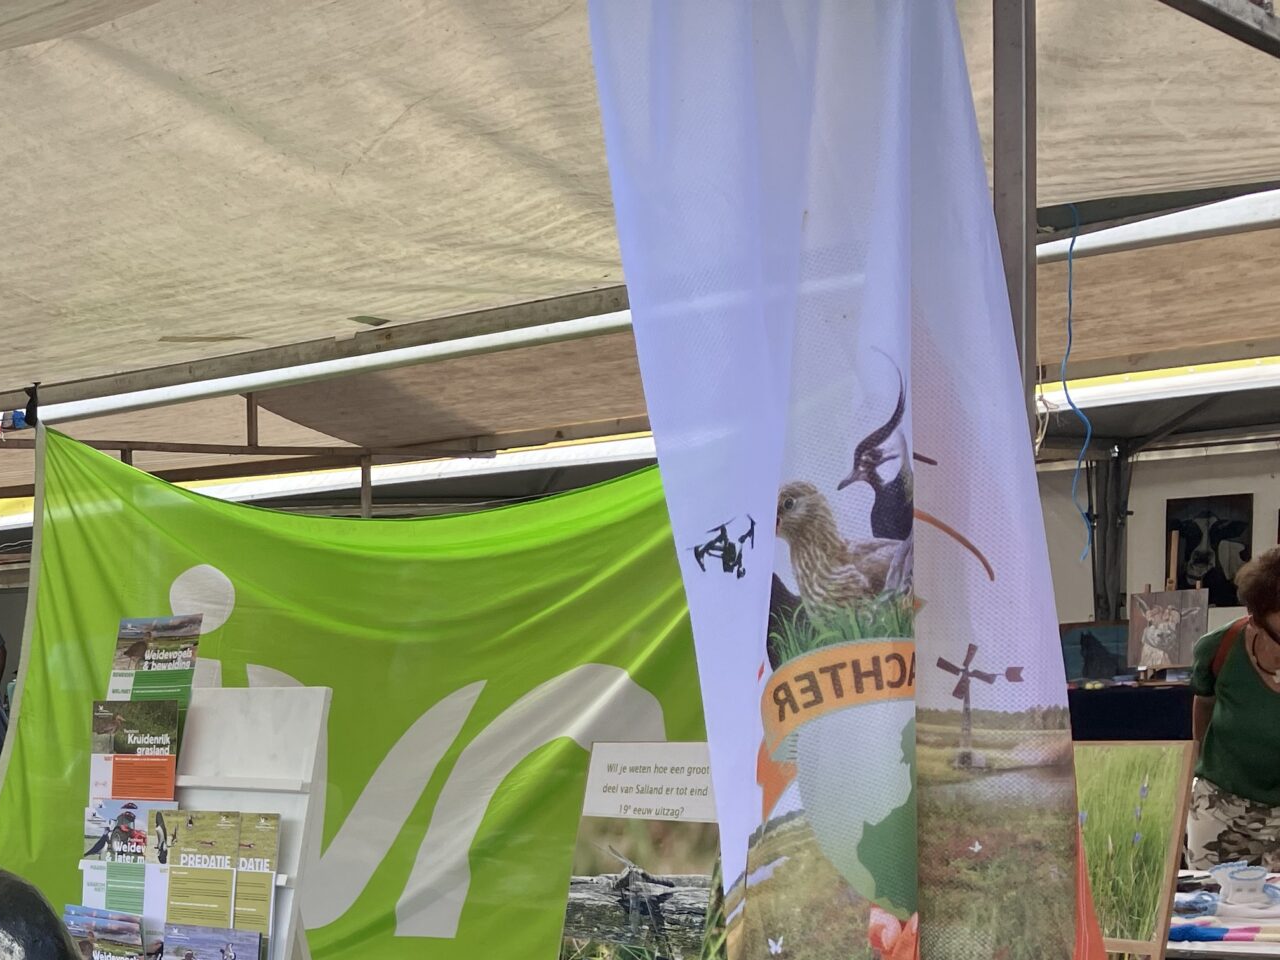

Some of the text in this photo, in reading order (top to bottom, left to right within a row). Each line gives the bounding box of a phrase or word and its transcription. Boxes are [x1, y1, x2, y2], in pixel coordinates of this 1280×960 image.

[127, 733, 171, 745] Kruidenrijk
[136, 745, 170, 756] grasland
[607, 763, 710, 777] Wil je weten hoe een groot
[602, 783, 708, 797] deel van Salland er tot eind
[633, 806, 653, 816] eeuw
[655, 806, 684, 819] uitzag?
[115, 852, 135, 864] later
[180, 853, 231, 869] PREDATIE
[239, 857, 270, 872] DATIE
